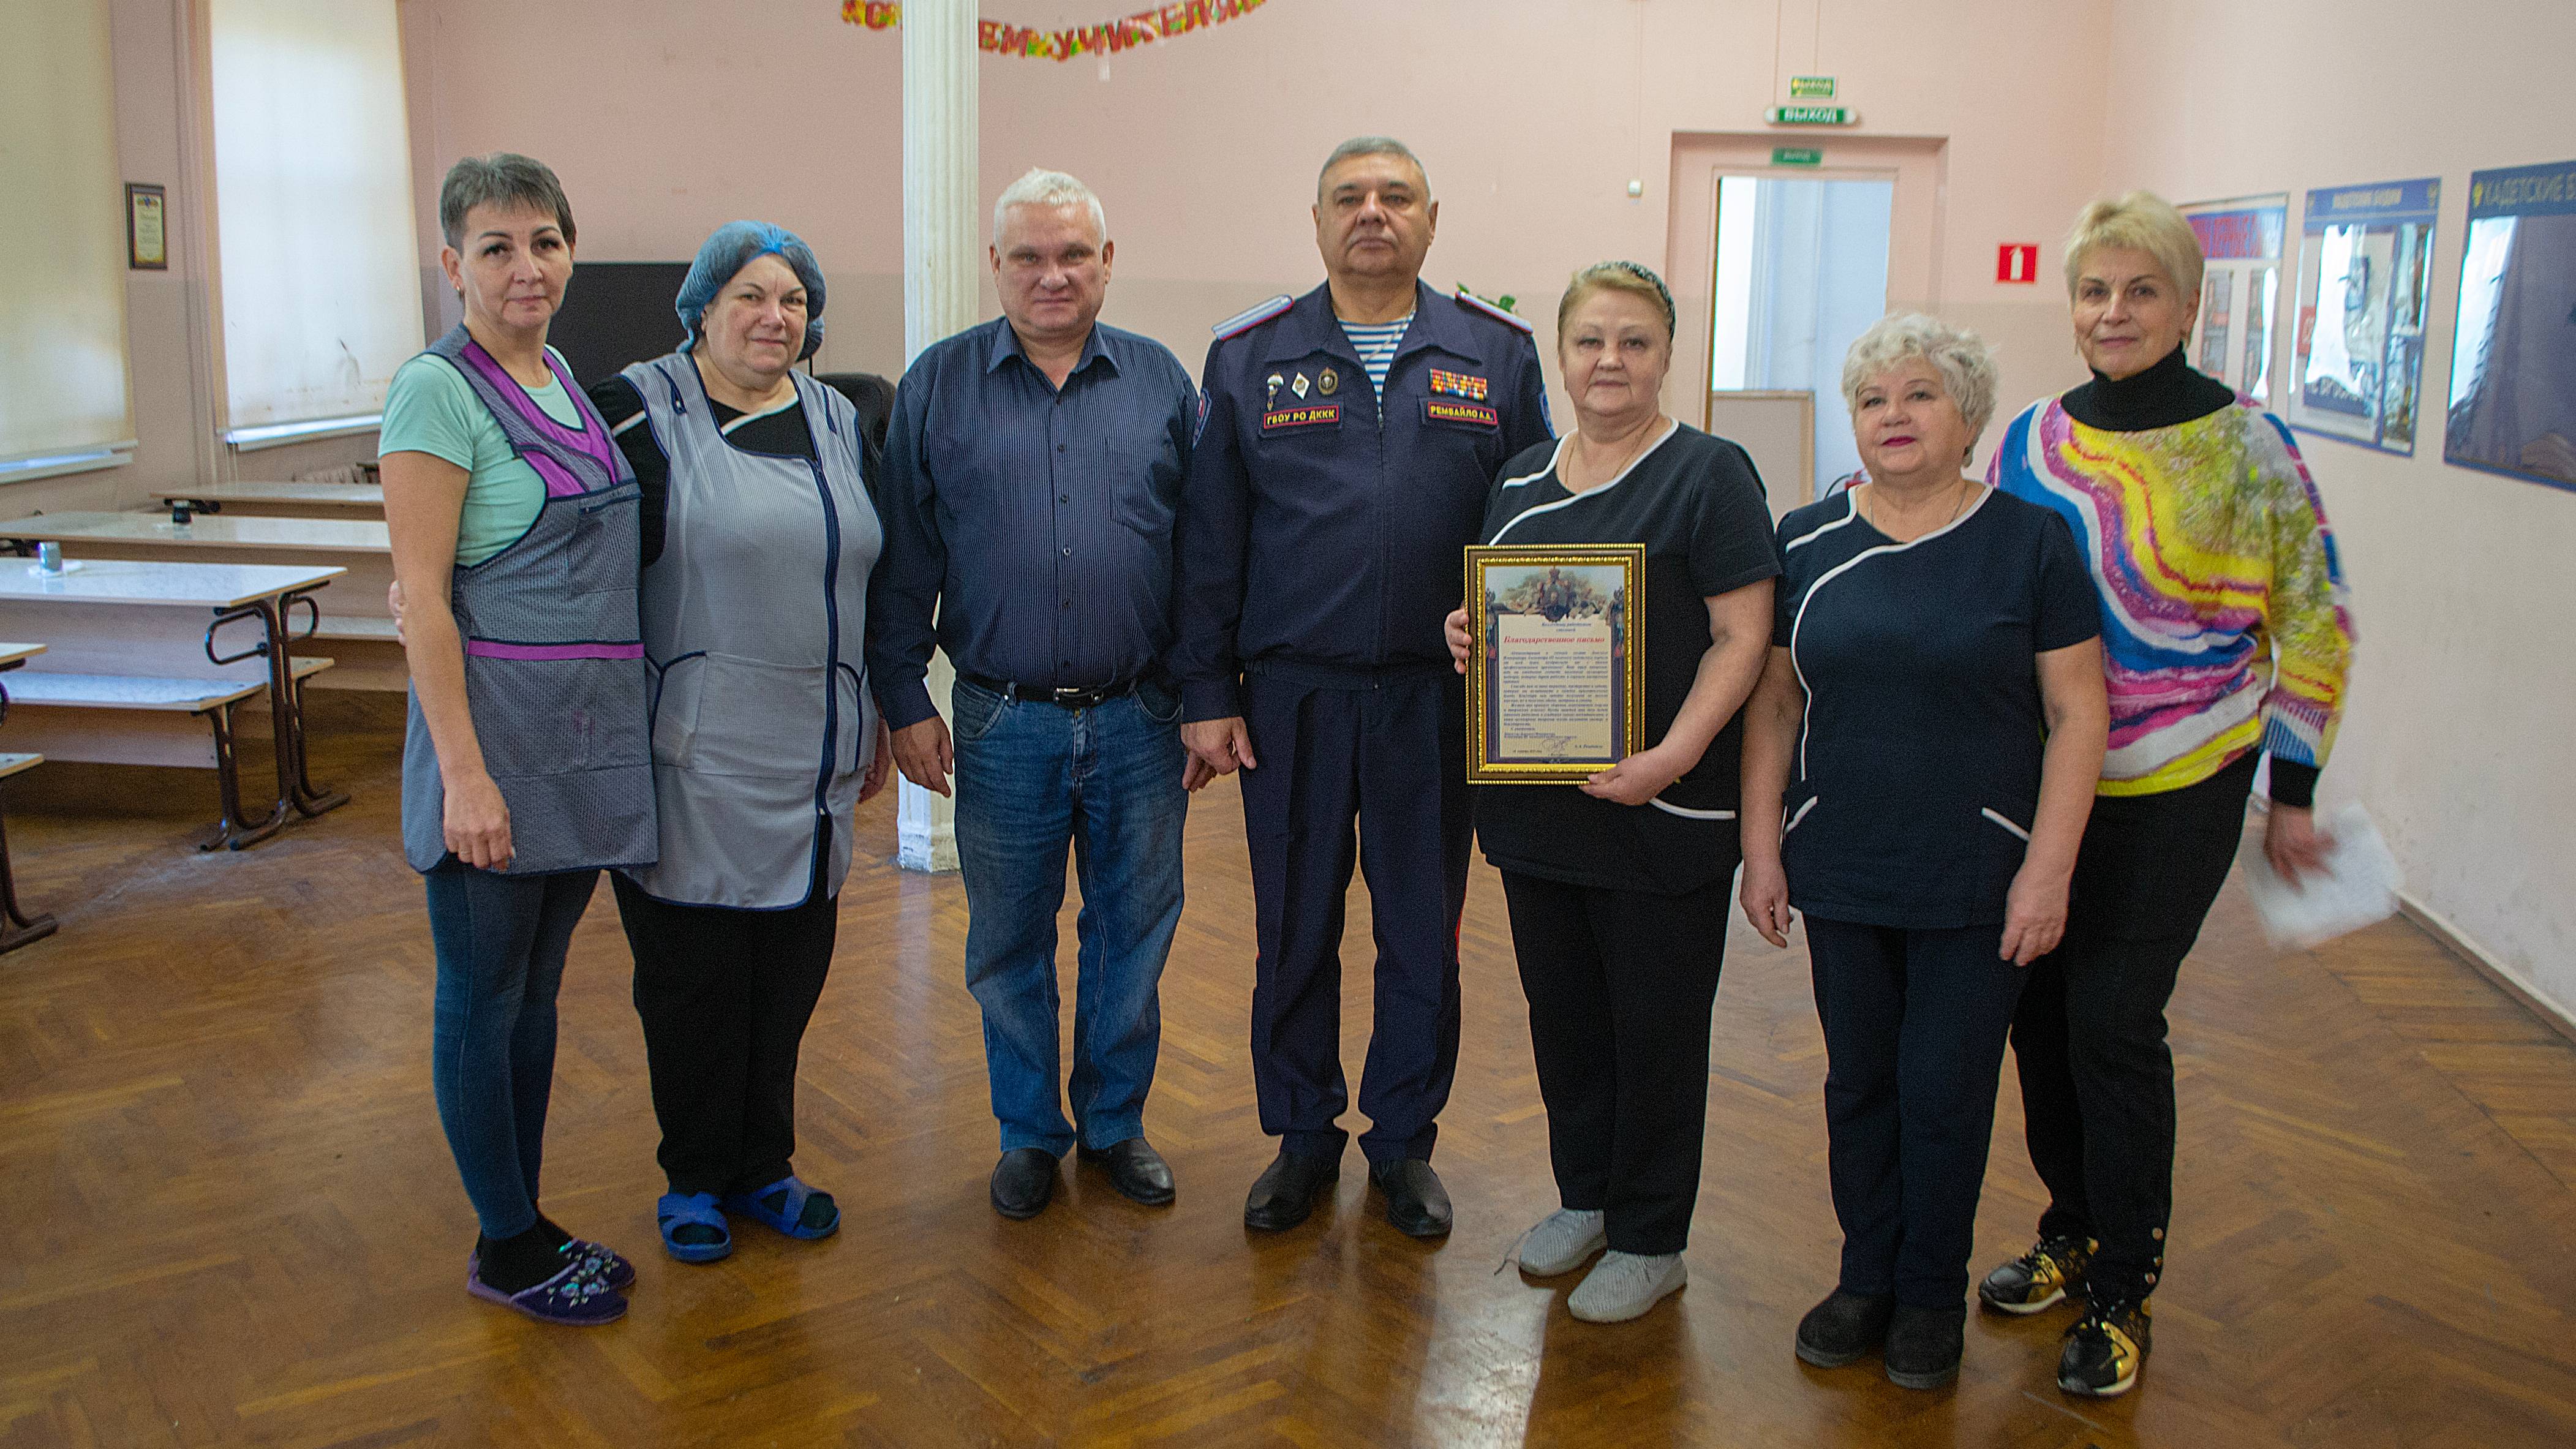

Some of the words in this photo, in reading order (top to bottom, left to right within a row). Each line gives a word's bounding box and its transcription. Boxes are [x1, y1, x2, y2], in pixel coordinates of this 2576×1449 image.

[1783, 107, 1837, 124] ВЫХОД
[1267, 413, 1290, 426] ГБОУ
[1293, 411, 1306, 421] РО
[1308, 409, 1335, 421] ДККК
[1431, 405, 1478, 419] РЕМБАЙЛО
[1504, 635, 1575, 644] Благодарственное
